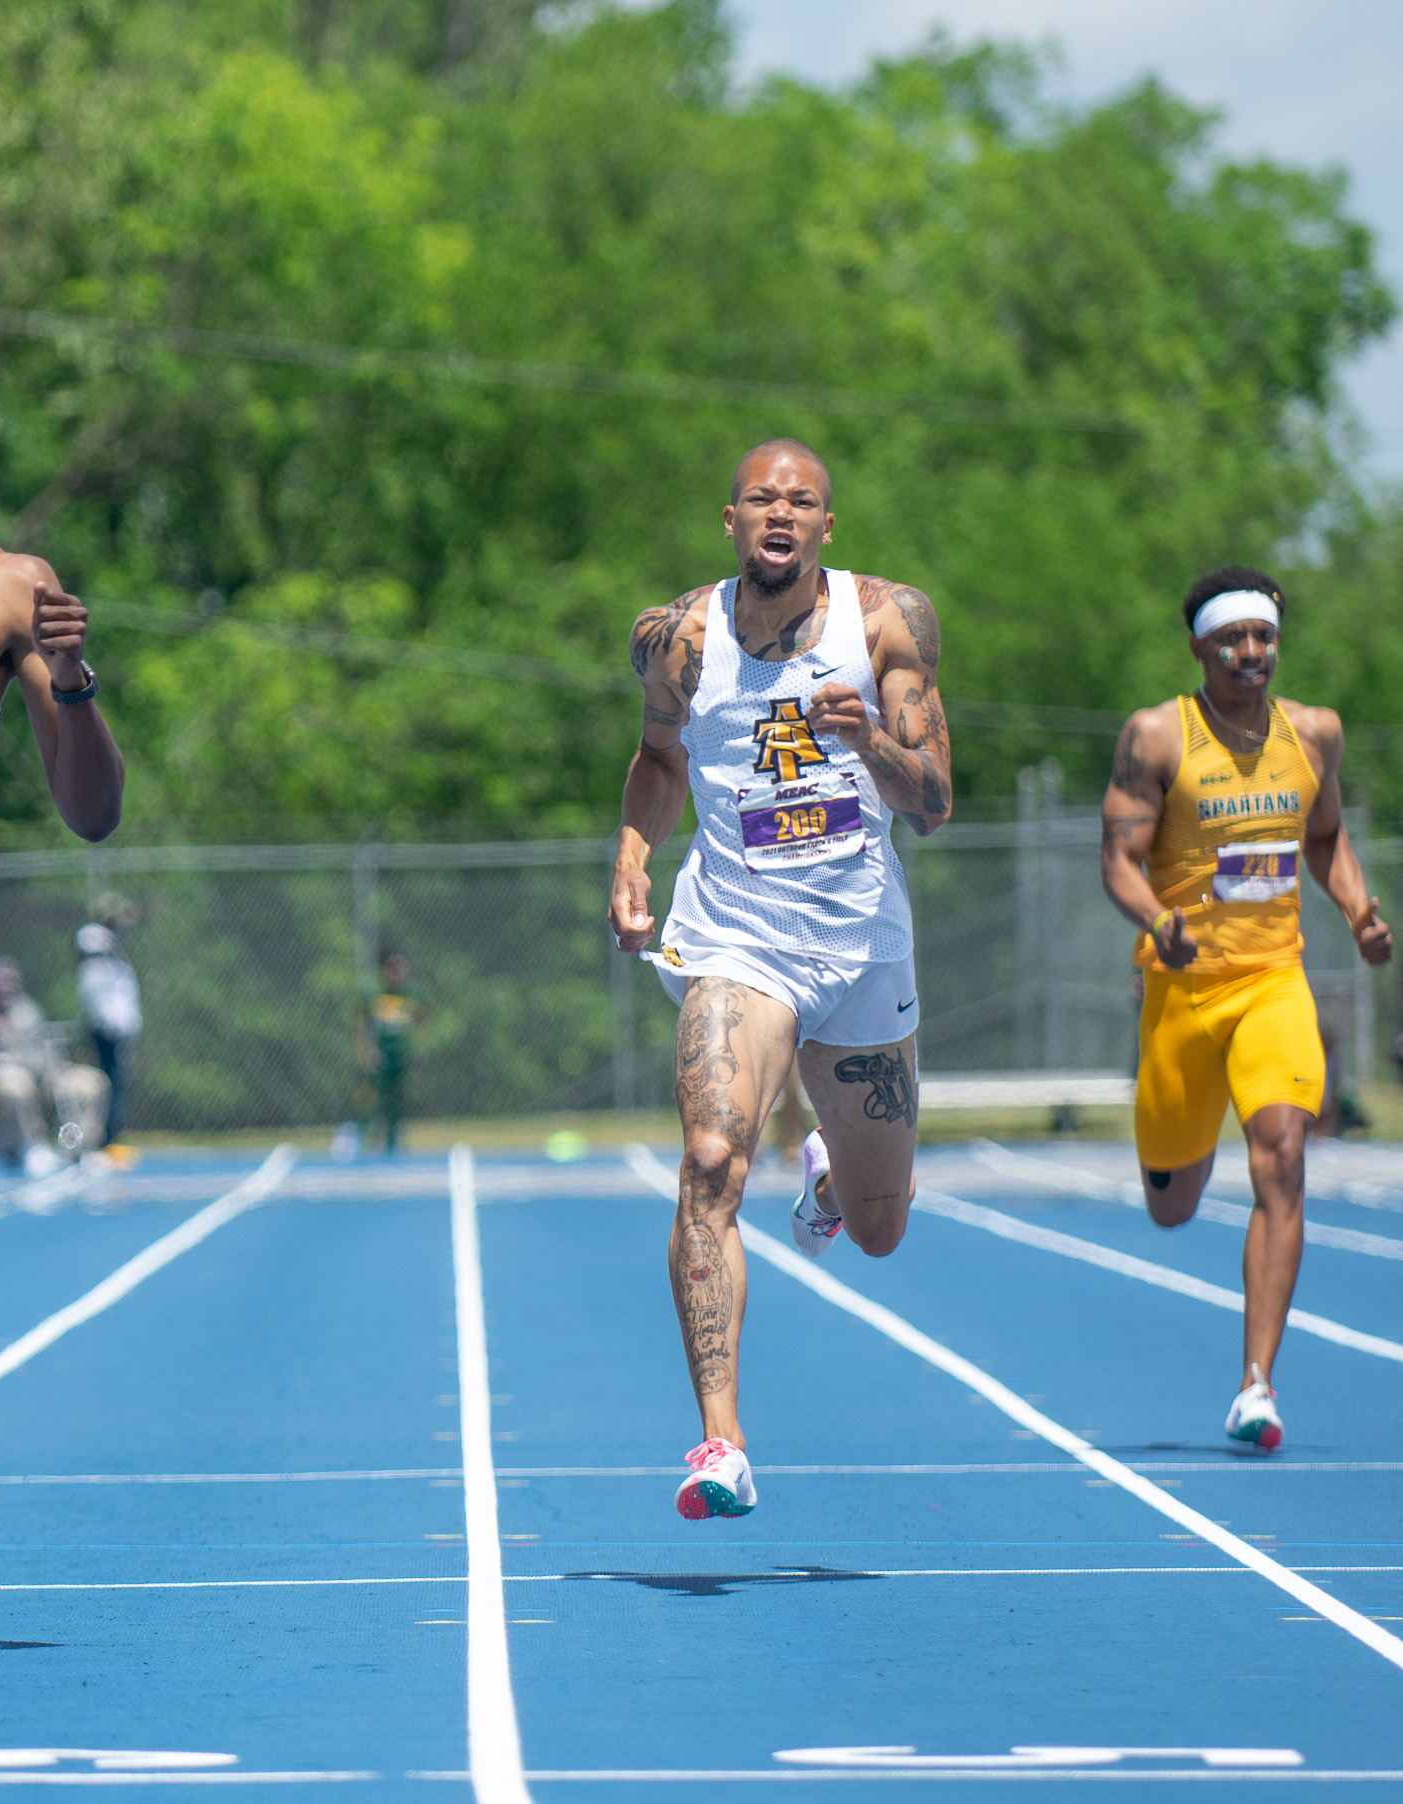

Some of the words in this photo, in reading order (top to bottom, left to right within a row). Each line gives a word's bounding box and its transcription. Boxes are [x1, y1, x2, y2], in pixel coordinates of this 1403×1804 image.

[775, 783, 819, 802] MEAC
[1197, 789, 1300, 821] SPARTANS
[777, 843, 806, 854] OUTDOOR
